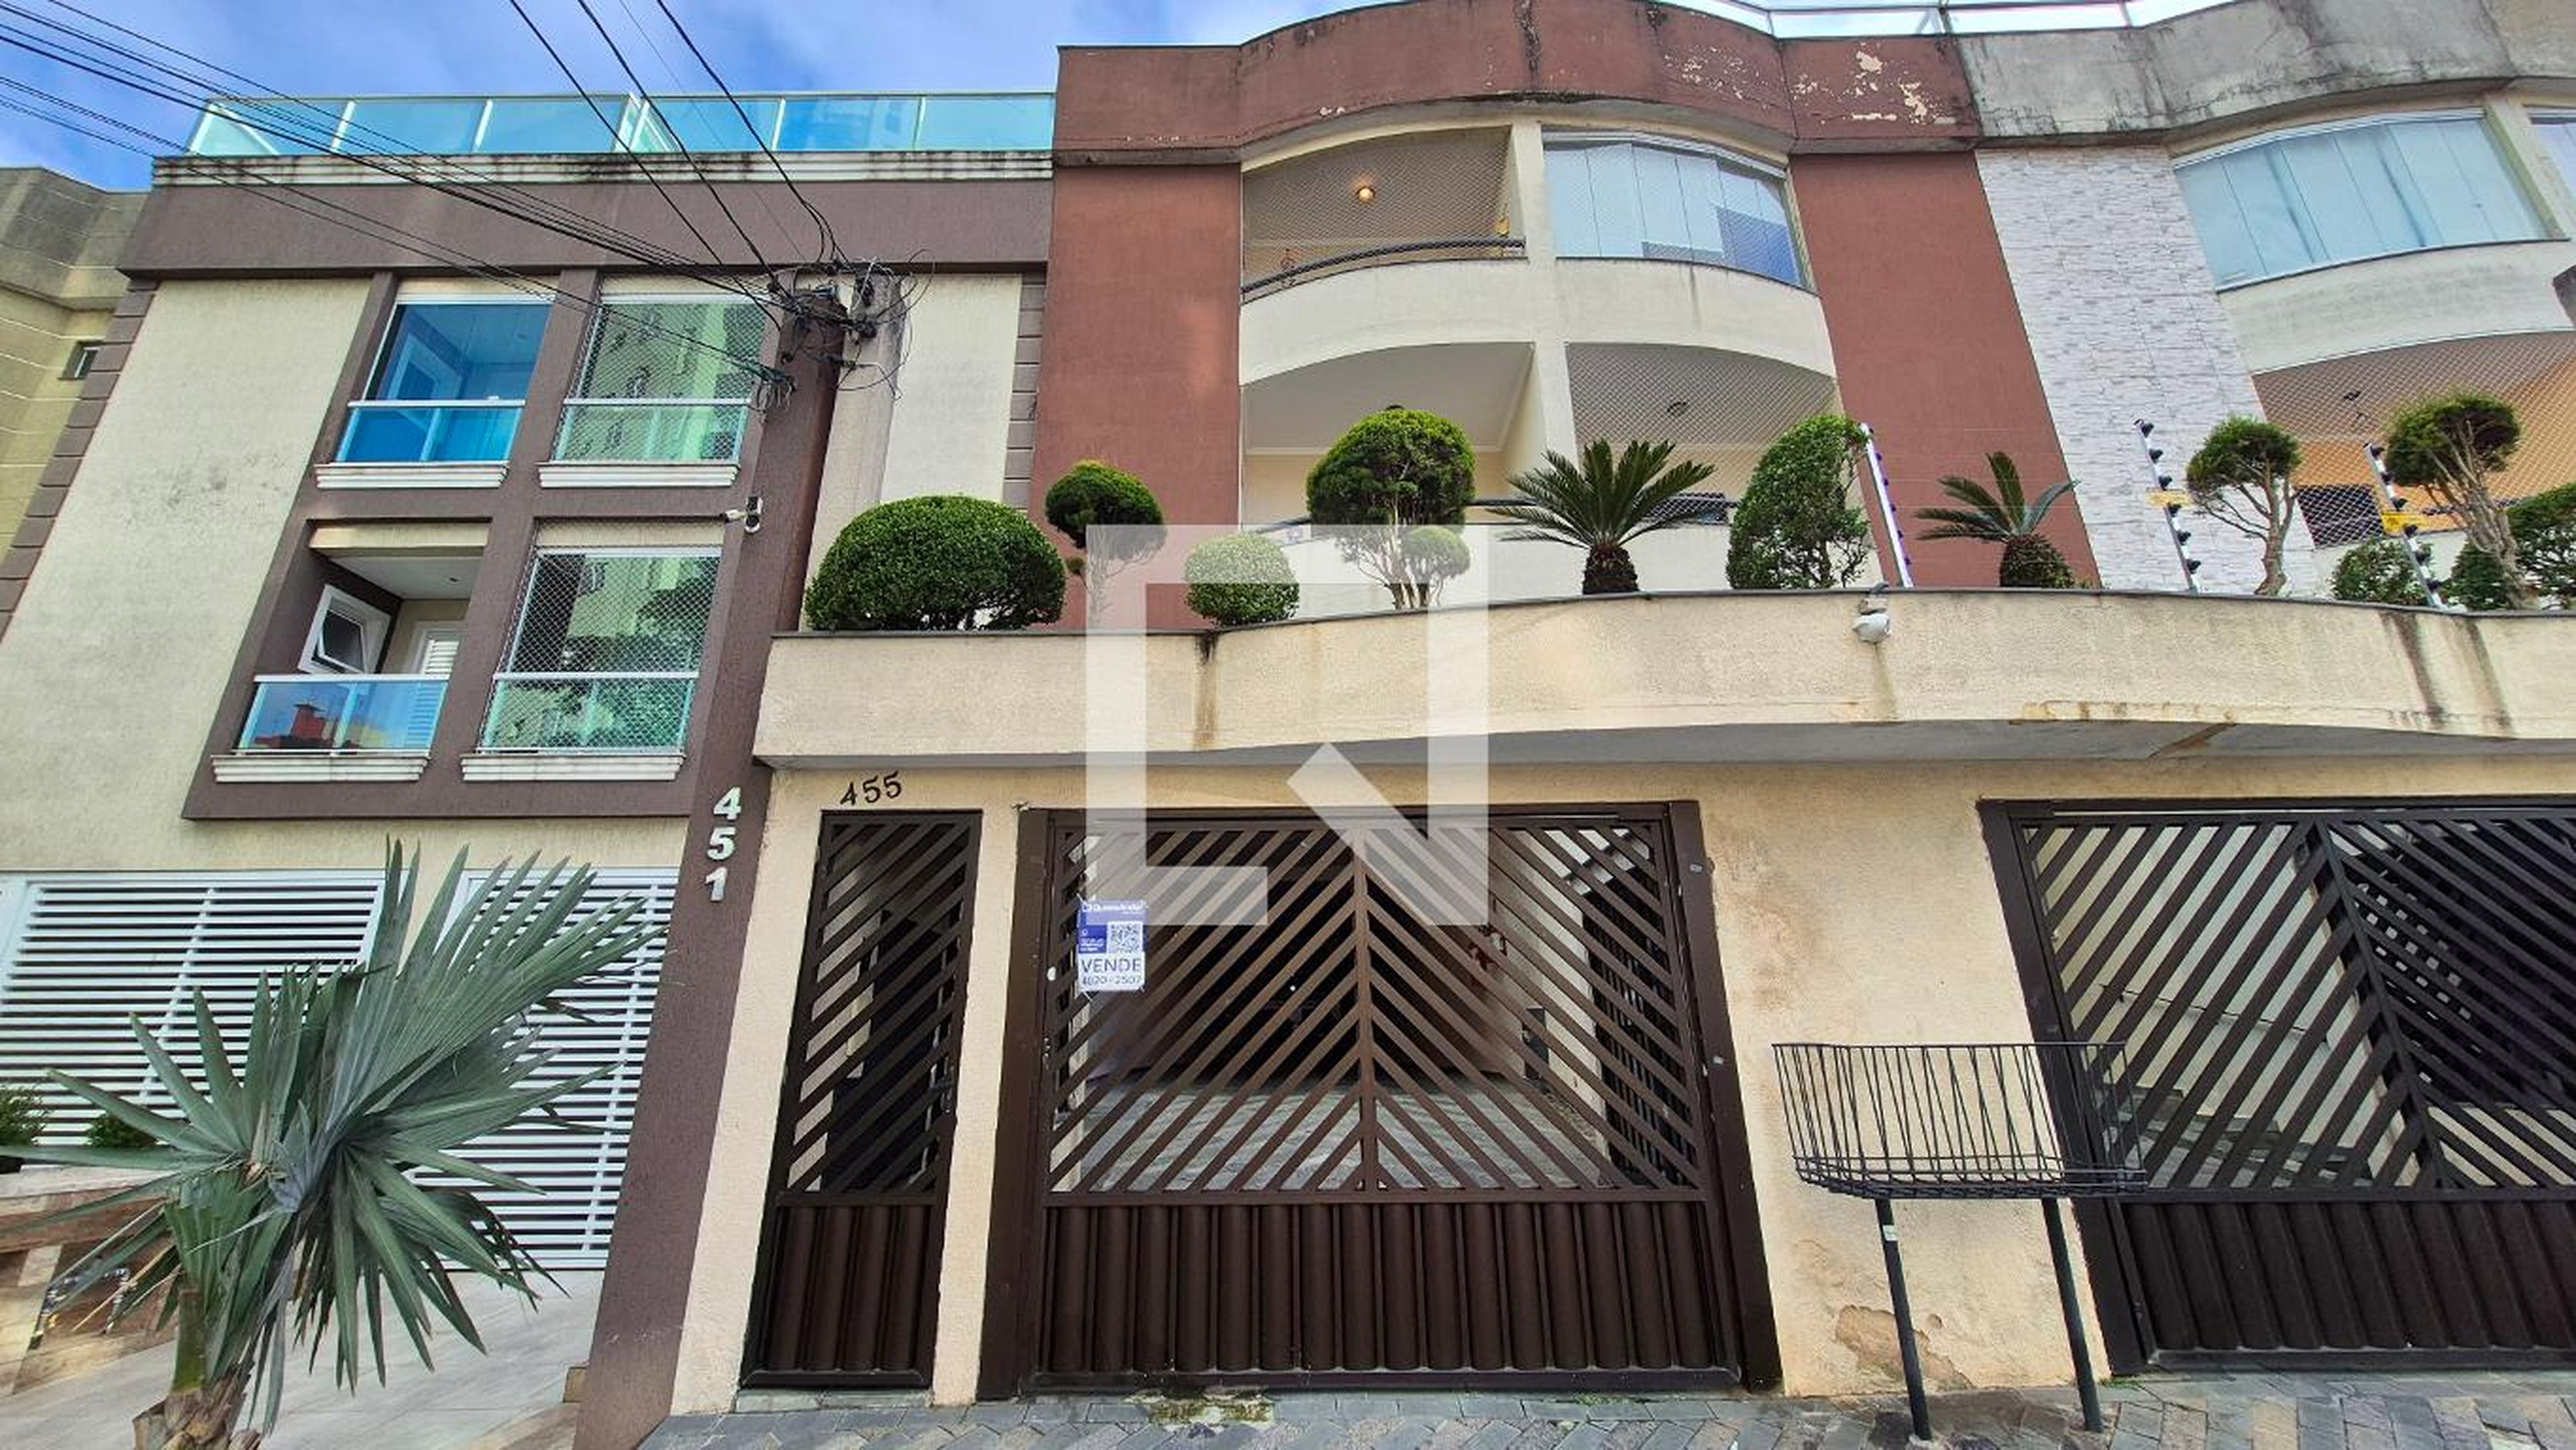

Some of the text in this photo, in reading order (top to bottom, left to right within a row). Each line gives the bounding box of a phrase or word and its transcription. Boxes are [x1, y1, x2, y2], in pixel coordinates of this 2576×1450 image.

[840, 771, 902, 805] 455
[705, 786, 741, 902] 451
[1081, 958, 1142, 972] VENDE
